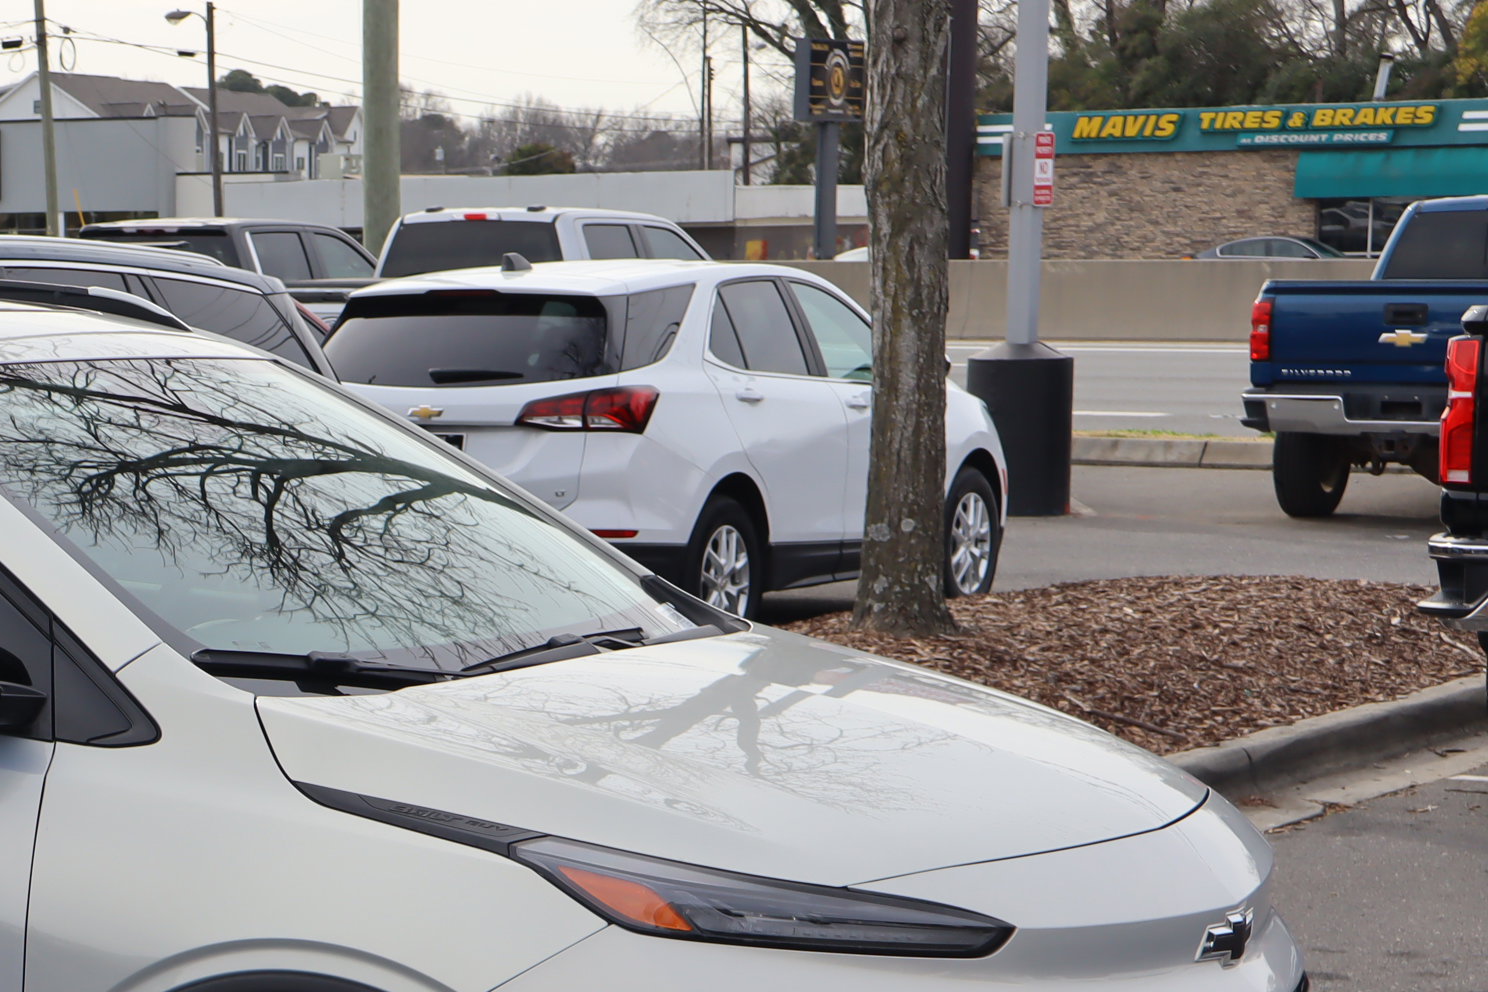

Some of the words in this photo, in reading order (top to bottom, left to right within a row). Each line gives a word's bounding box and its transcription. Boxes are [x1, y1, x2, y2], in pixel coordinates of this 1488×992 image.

[1072, 113, 1180, 139] MAVIS
[1199, 110, 1282, 130] TIRES
[1287, 112, 1307, 127] &
[1312, 105, 1437, 127] BRAKES
[1254, 134, 1329, 144] DISCOUNT
[1332, 132, 1388, 143] PRICES
[555, 490, 568, 498] LT
[391, 806, 463, 822] BOLT
[467, 820, 509, 831] EUV
